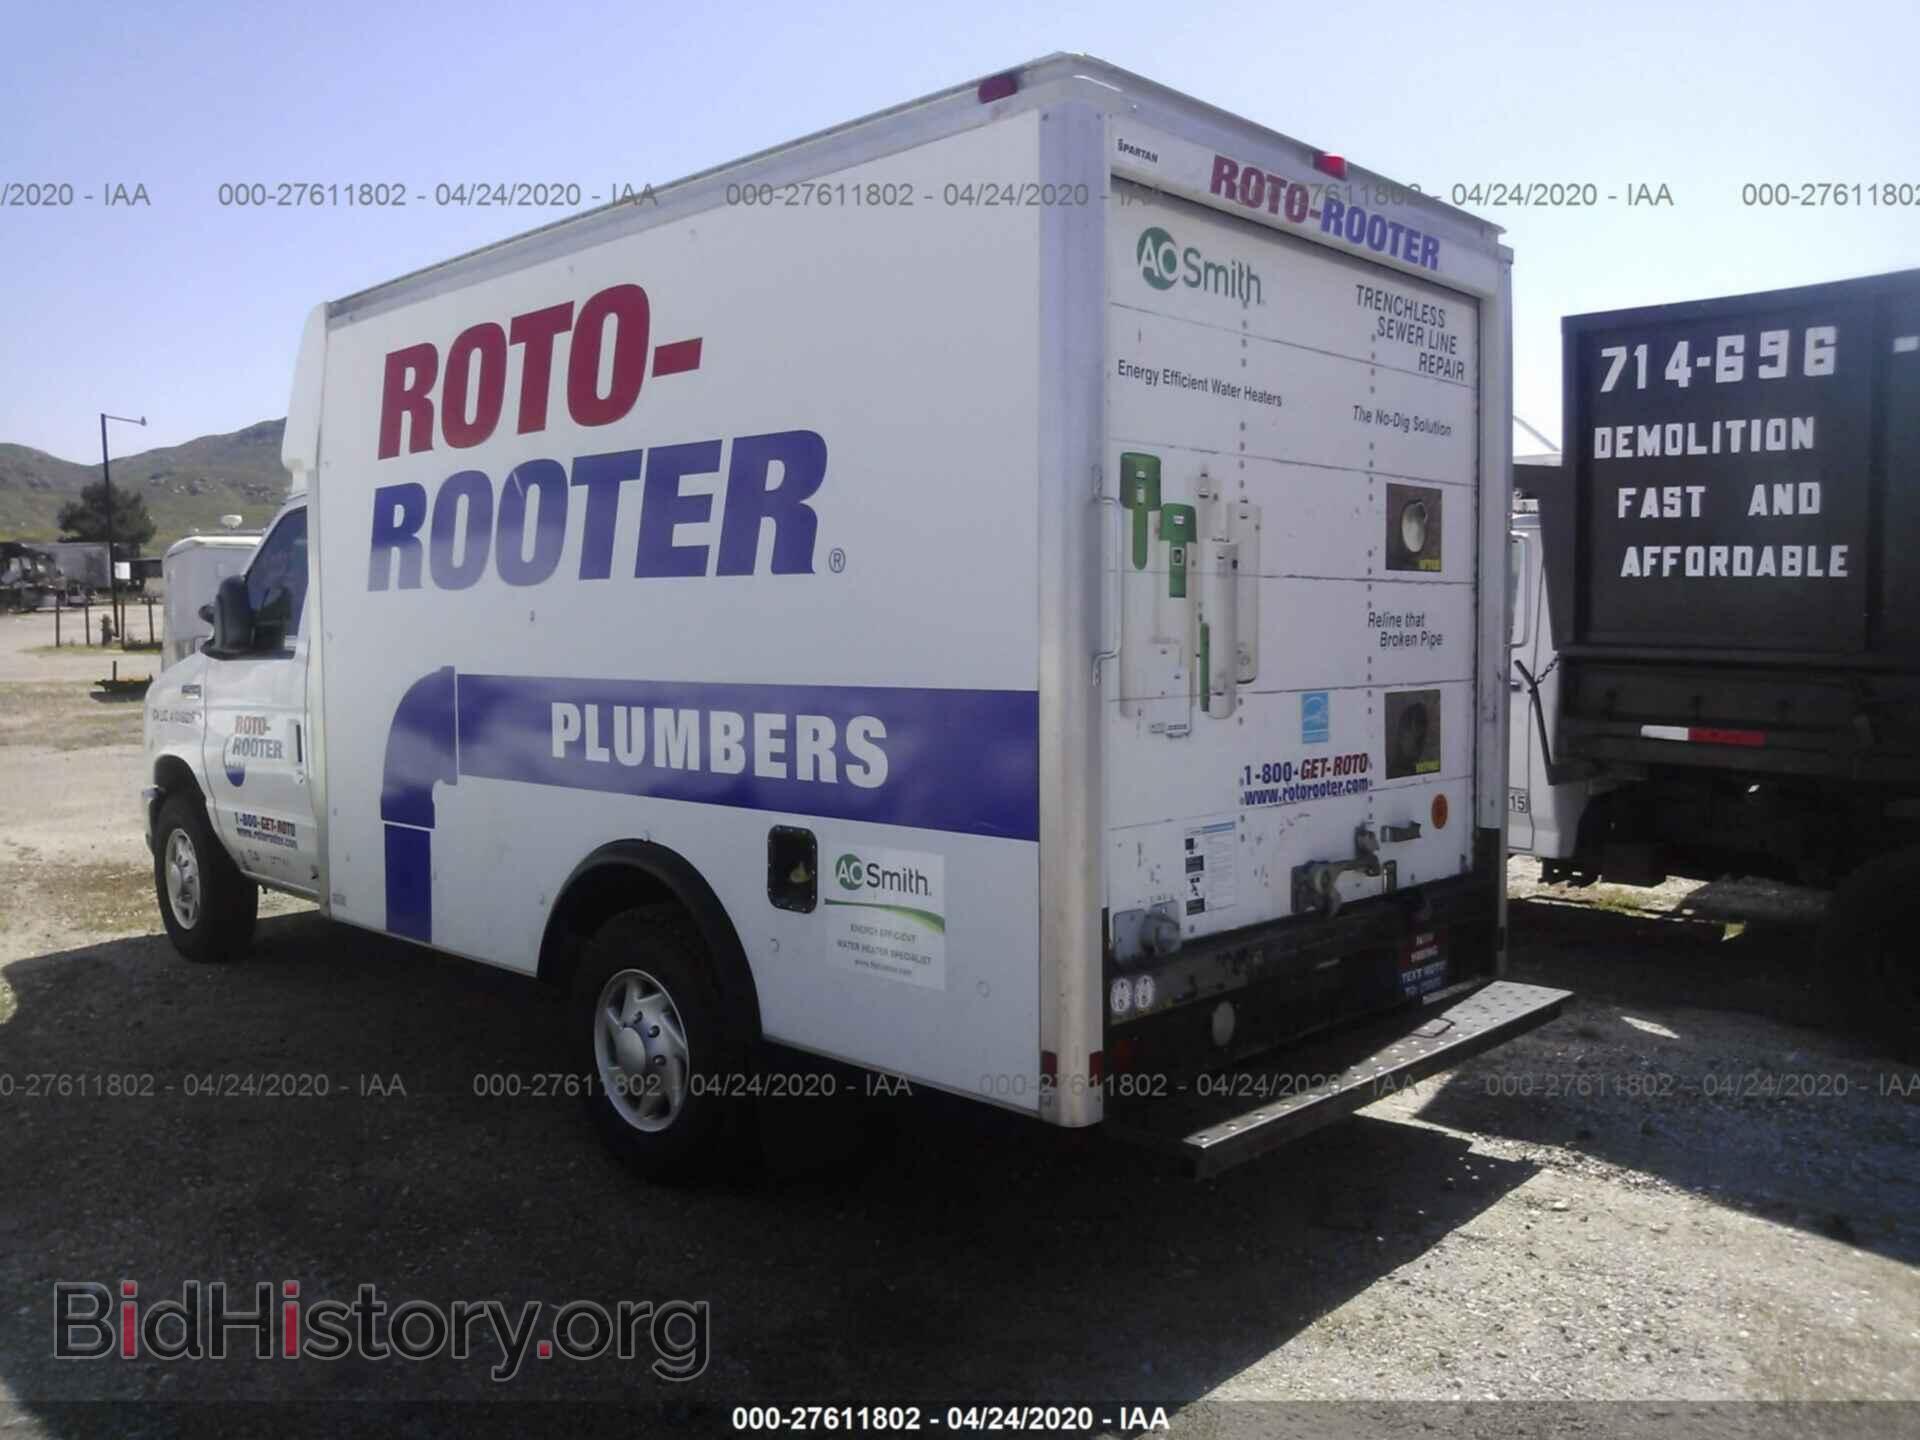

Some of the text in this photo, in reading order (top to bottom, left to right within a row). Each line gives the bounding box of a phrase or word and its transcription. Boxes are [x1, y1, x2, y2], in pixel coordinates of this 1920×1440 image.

[1117, 138, 1159, 164] SPARTAN
[1209, 154, 1440, 270] ROTO-ROOTER
[1356, 284, 1447, 329] TRENCHLESS
[1377, 315, 1458, 356] SEWER LINE
[377, 284, 703, 461] ROTO-
[1418, 351, 1466, 382] REPAIR
[1600, 325, 1837, 393] 714-696
[1117, 358, 1283, 408] Energy Efficient Water Heaters
[1353, 405, 1453, 437] The No-Dig Solution
[1593, 416, 1815, 460] DEMOLITION
[367, 430, 829, 592] ROOTER
[1617, 481, 1822, 519] FAST AND
[1620, 544, 1849, 578] AFFORDABLE
[1367, 611, 1426, 628] Reline that
[1379, 630, 1444, 651] Broken Pipe
[232, 737, 284, 760] ROOTER
[551, 701, 889, 789] PLUMBERS
[1244, 752, 1369, 786] 1-800-GET-ROTO
[1244, 777, 1369, 806] www.rotorooter.com
